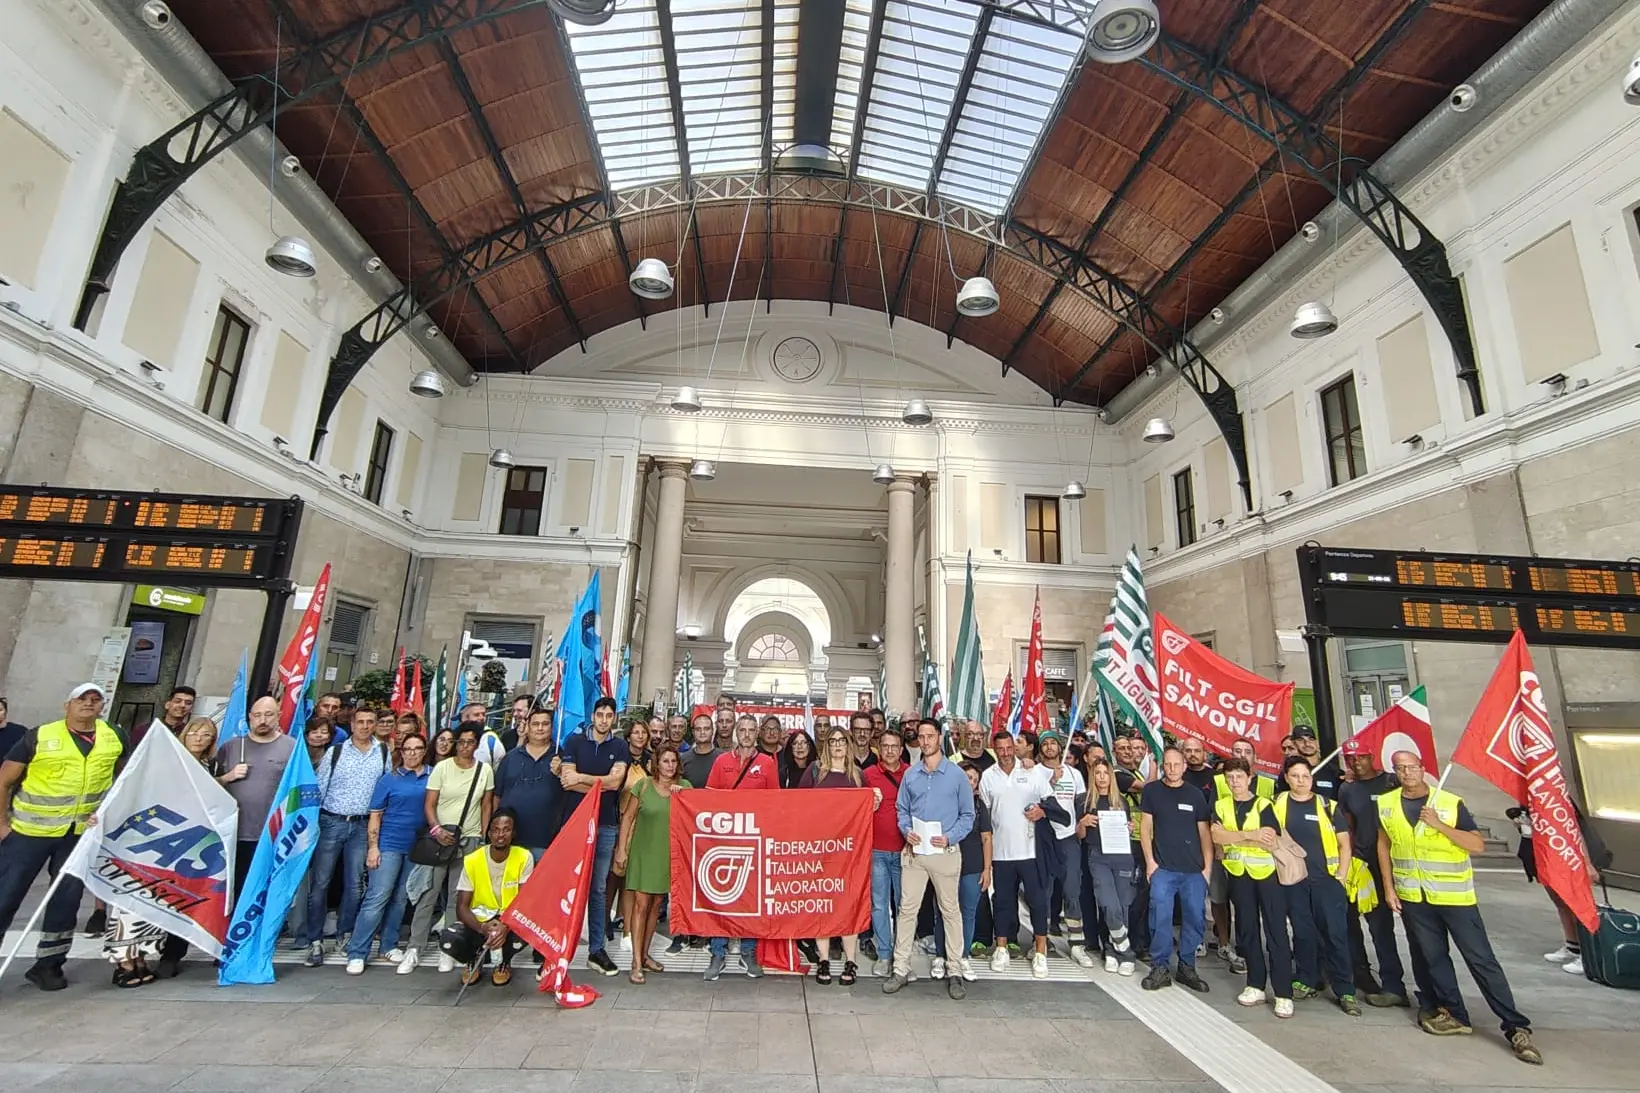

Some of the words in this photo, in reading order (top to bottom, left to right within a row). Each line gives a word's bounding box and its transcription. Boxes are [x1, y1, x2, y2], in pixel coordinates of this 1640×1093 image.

[1164, 658, 1213, 697] FILT
[1218, 692, 1277, 722] CGIL
[1163, 684, 1261, 742] SAVONA
[695, 811, 760, 835] CGIL
[103, 803, 228, 879] FAS
[765, 836, 854, 856] FEDERAZIONE
[765, 858, 824, 875] ITALIANA
[765, 878, 845, 896] LAVORATORI
[764, 897, 833, 916] TRASPORTI
[511, 909, 562, 953] FEDERAZIONE
